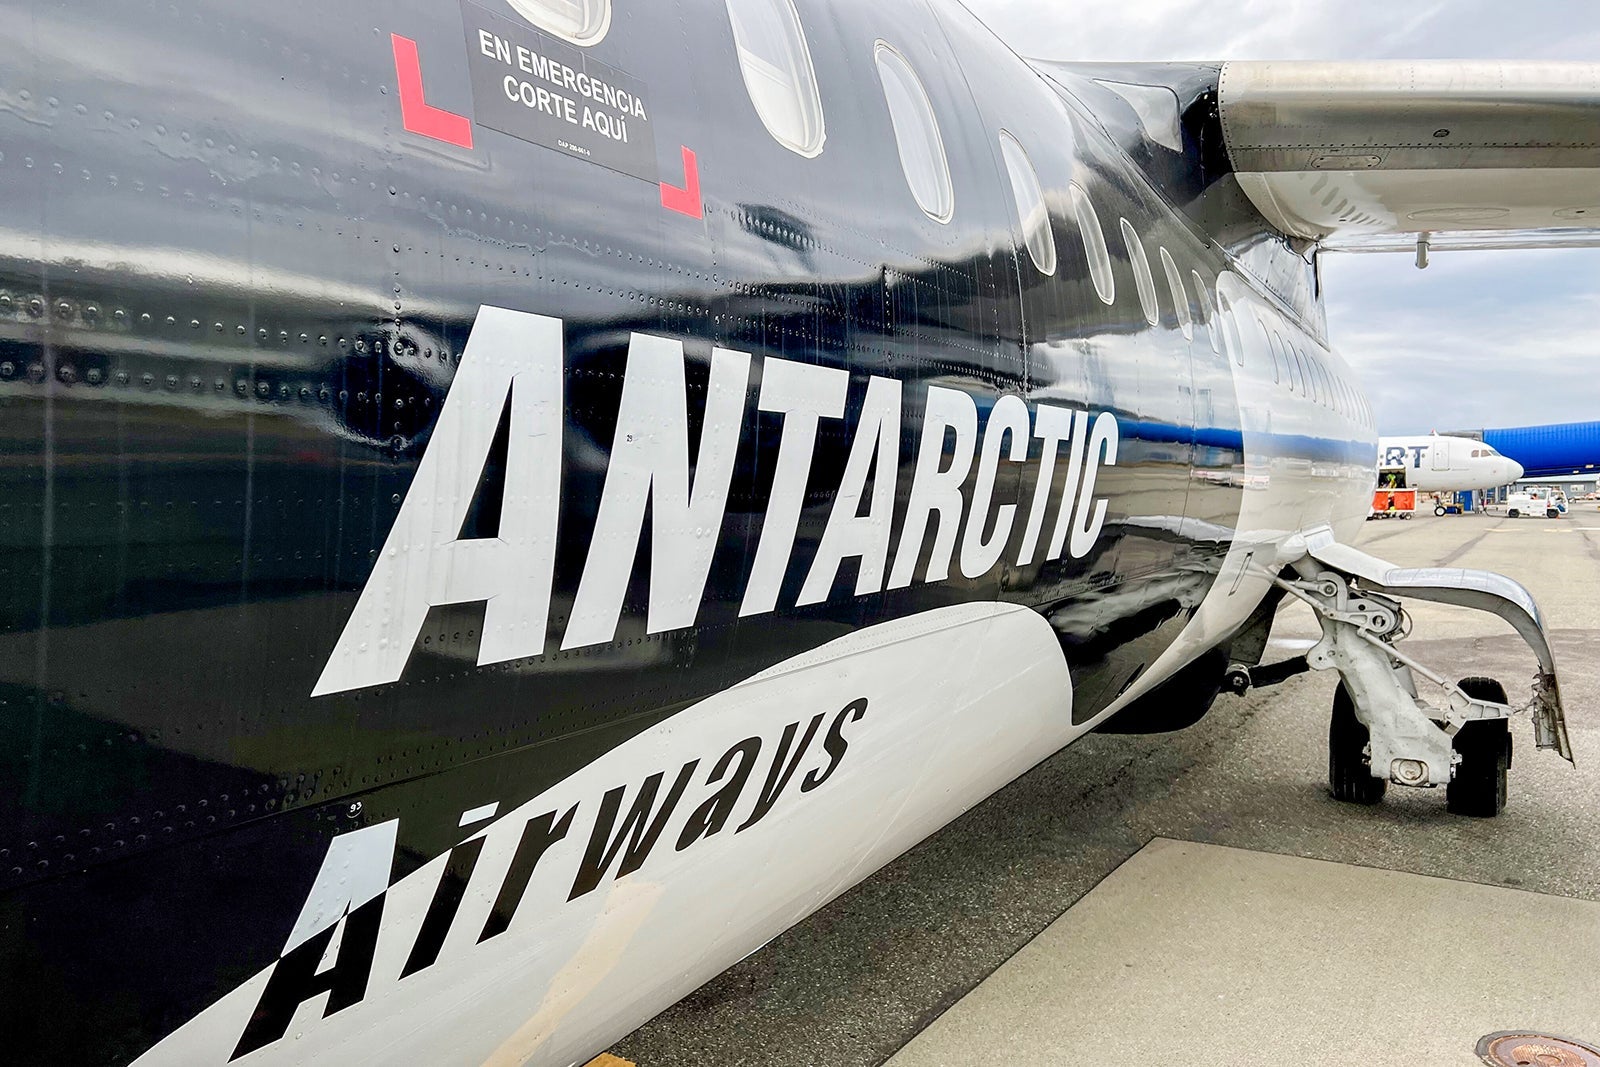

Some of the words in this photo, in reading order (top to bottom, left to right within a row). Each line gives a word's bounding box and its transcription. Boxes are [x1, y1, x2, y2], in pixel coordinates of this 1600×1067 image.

[478, 28, 512, 65] EN
[516, 45, 648, 121] EMERGENCIA
[503, 75, 578, 125] CORTE
[582, 105, 628, 143] AQUÍ
[1385, 445, 1429, 468] RT
[311, 304, 1118, 697] ANTARCTIC
[350, 801, 362, 812] 93
[227, 697, 868, 1064] Airways
